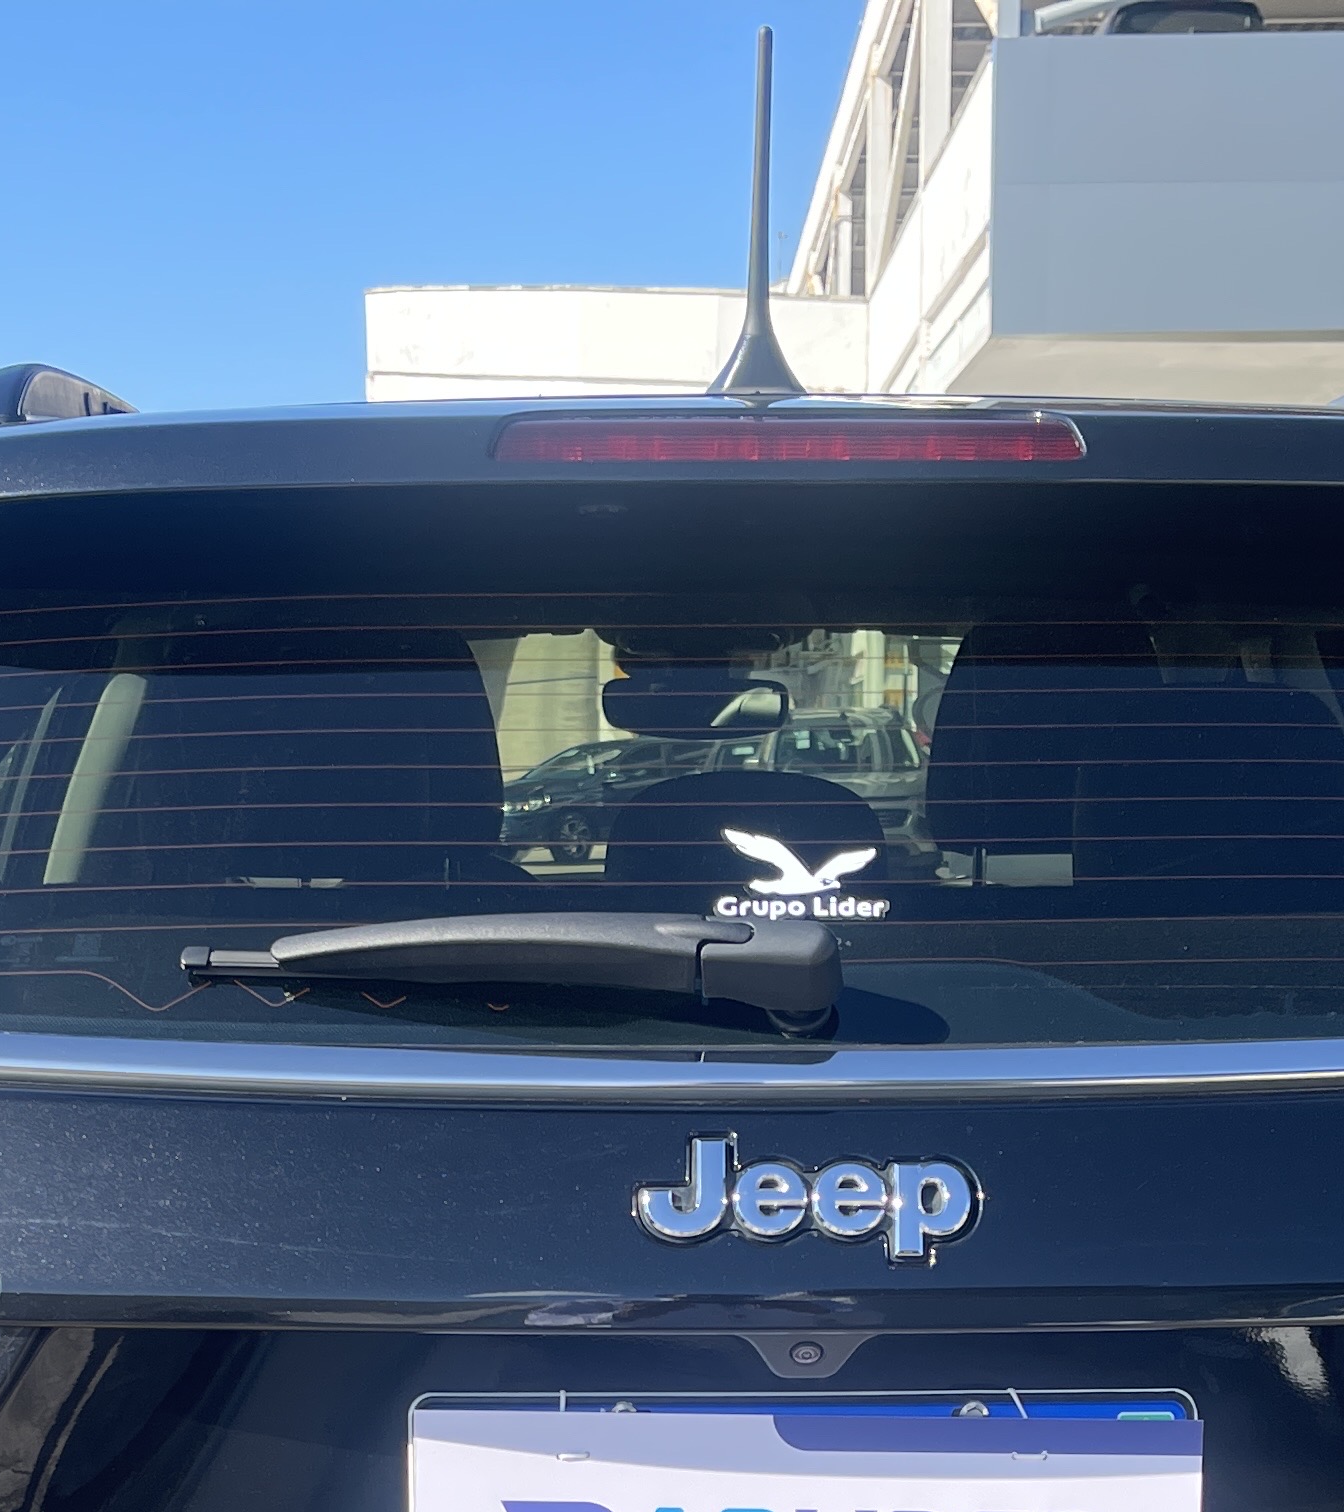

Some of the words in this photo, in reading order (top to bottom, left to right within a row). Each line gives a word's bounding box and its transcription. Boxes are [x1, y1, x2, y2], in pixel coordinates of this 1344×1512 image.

[716, 896, 806, 920] Grupo
[812, 896, 886, 918] Lider
[634, 1134, 982, 1262] Jeep
